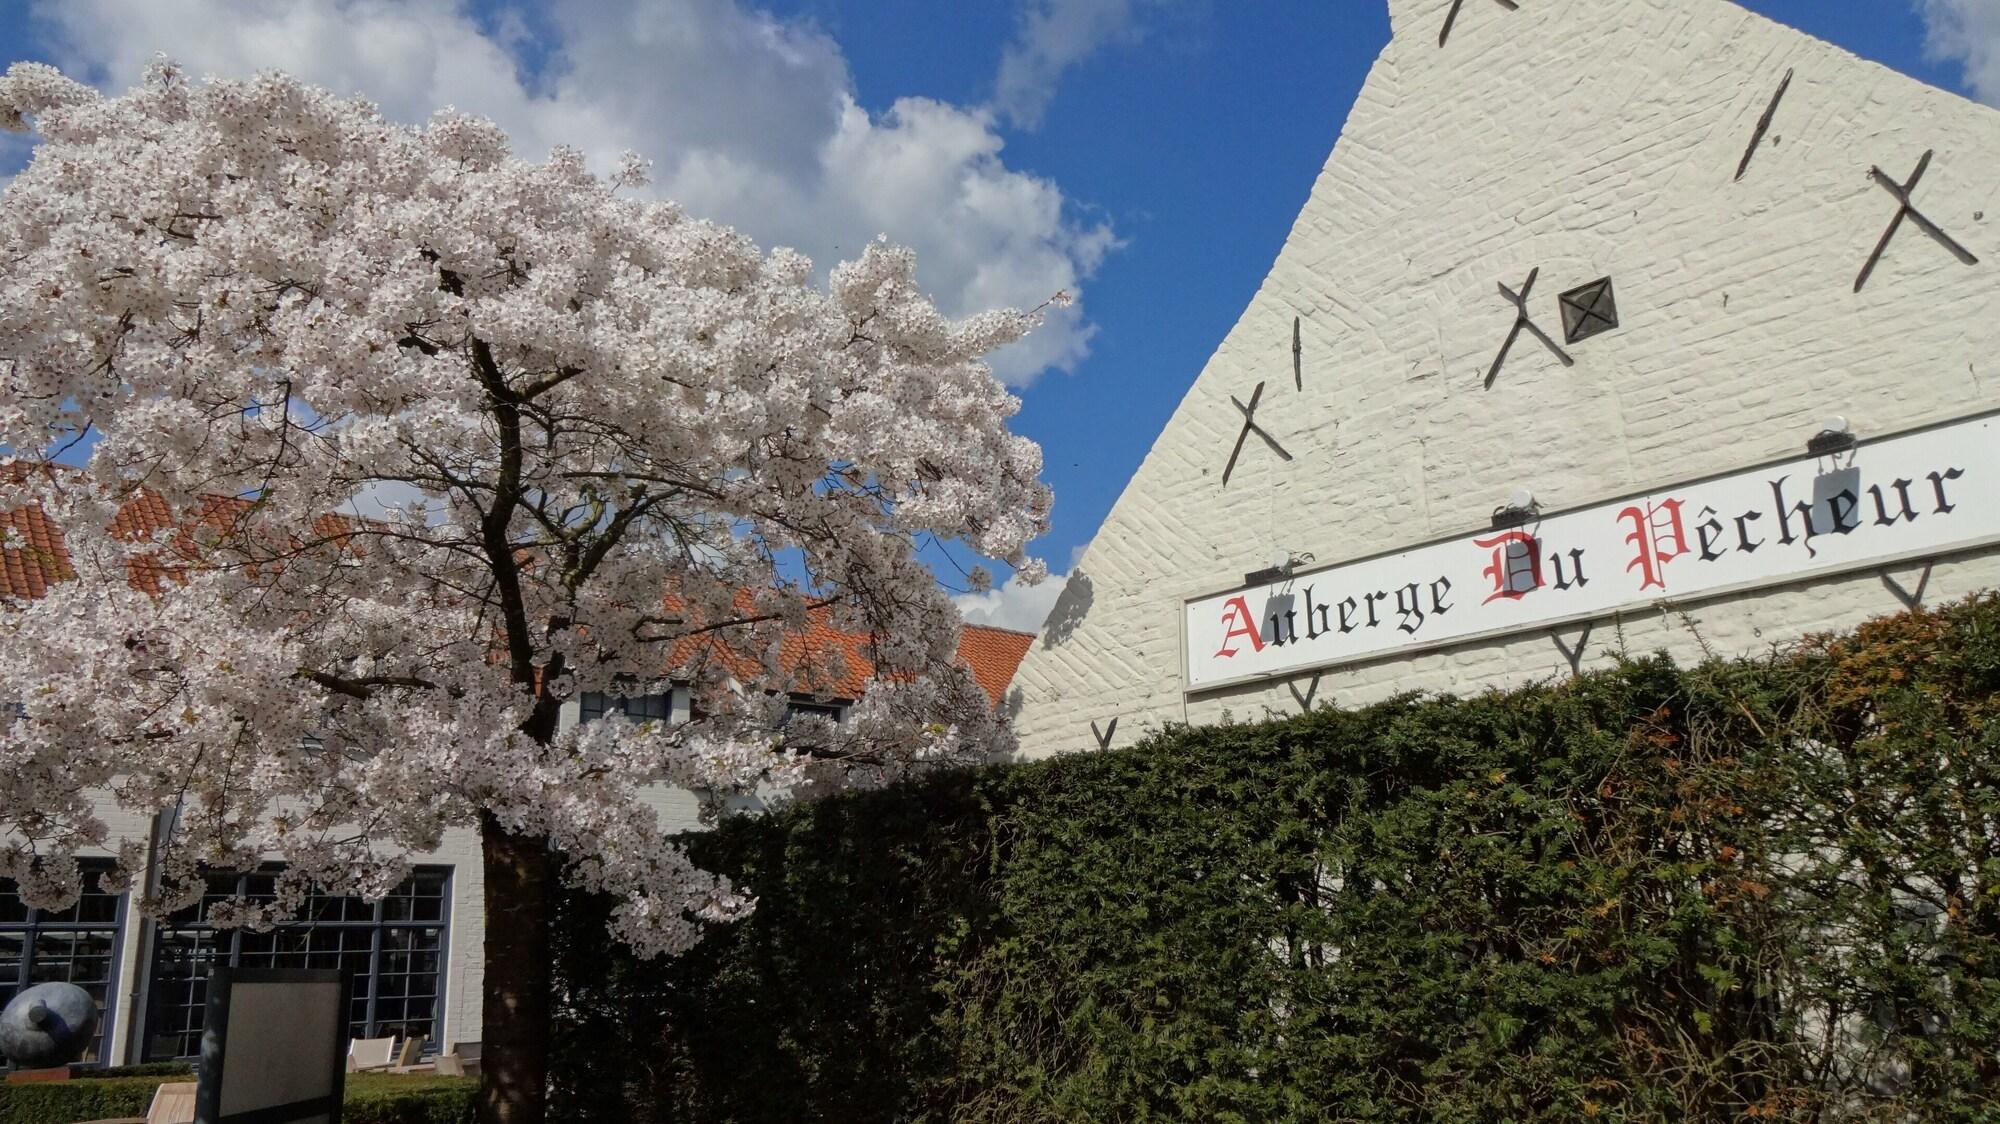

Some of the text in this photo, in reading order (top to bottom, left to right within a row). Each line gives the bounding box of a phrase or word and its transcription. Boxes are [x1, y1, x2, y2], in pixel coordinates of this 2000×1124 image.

[1213, 466, 1966, 660] Auberge Du Pêcheur
